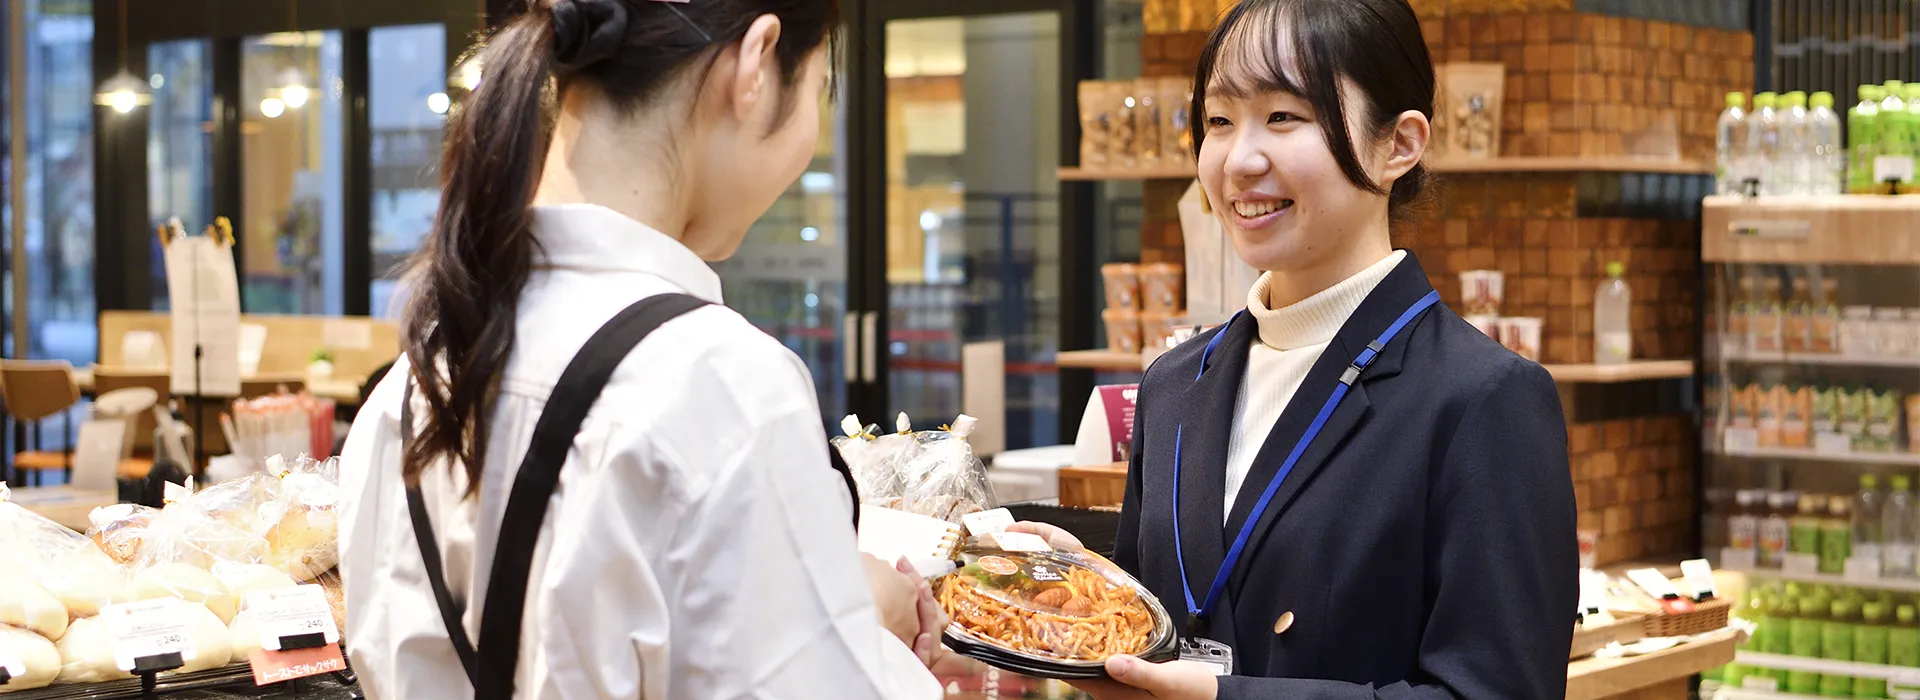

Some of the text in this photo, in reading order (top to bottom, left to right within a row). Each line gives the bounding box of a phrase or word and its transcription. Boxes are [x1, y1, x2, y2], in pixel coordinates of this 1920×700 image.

[306, 620, 324, 628] 240
[163, 634, 181, 645] 240
[262, 659, 338, 681] トーストでサックサク
